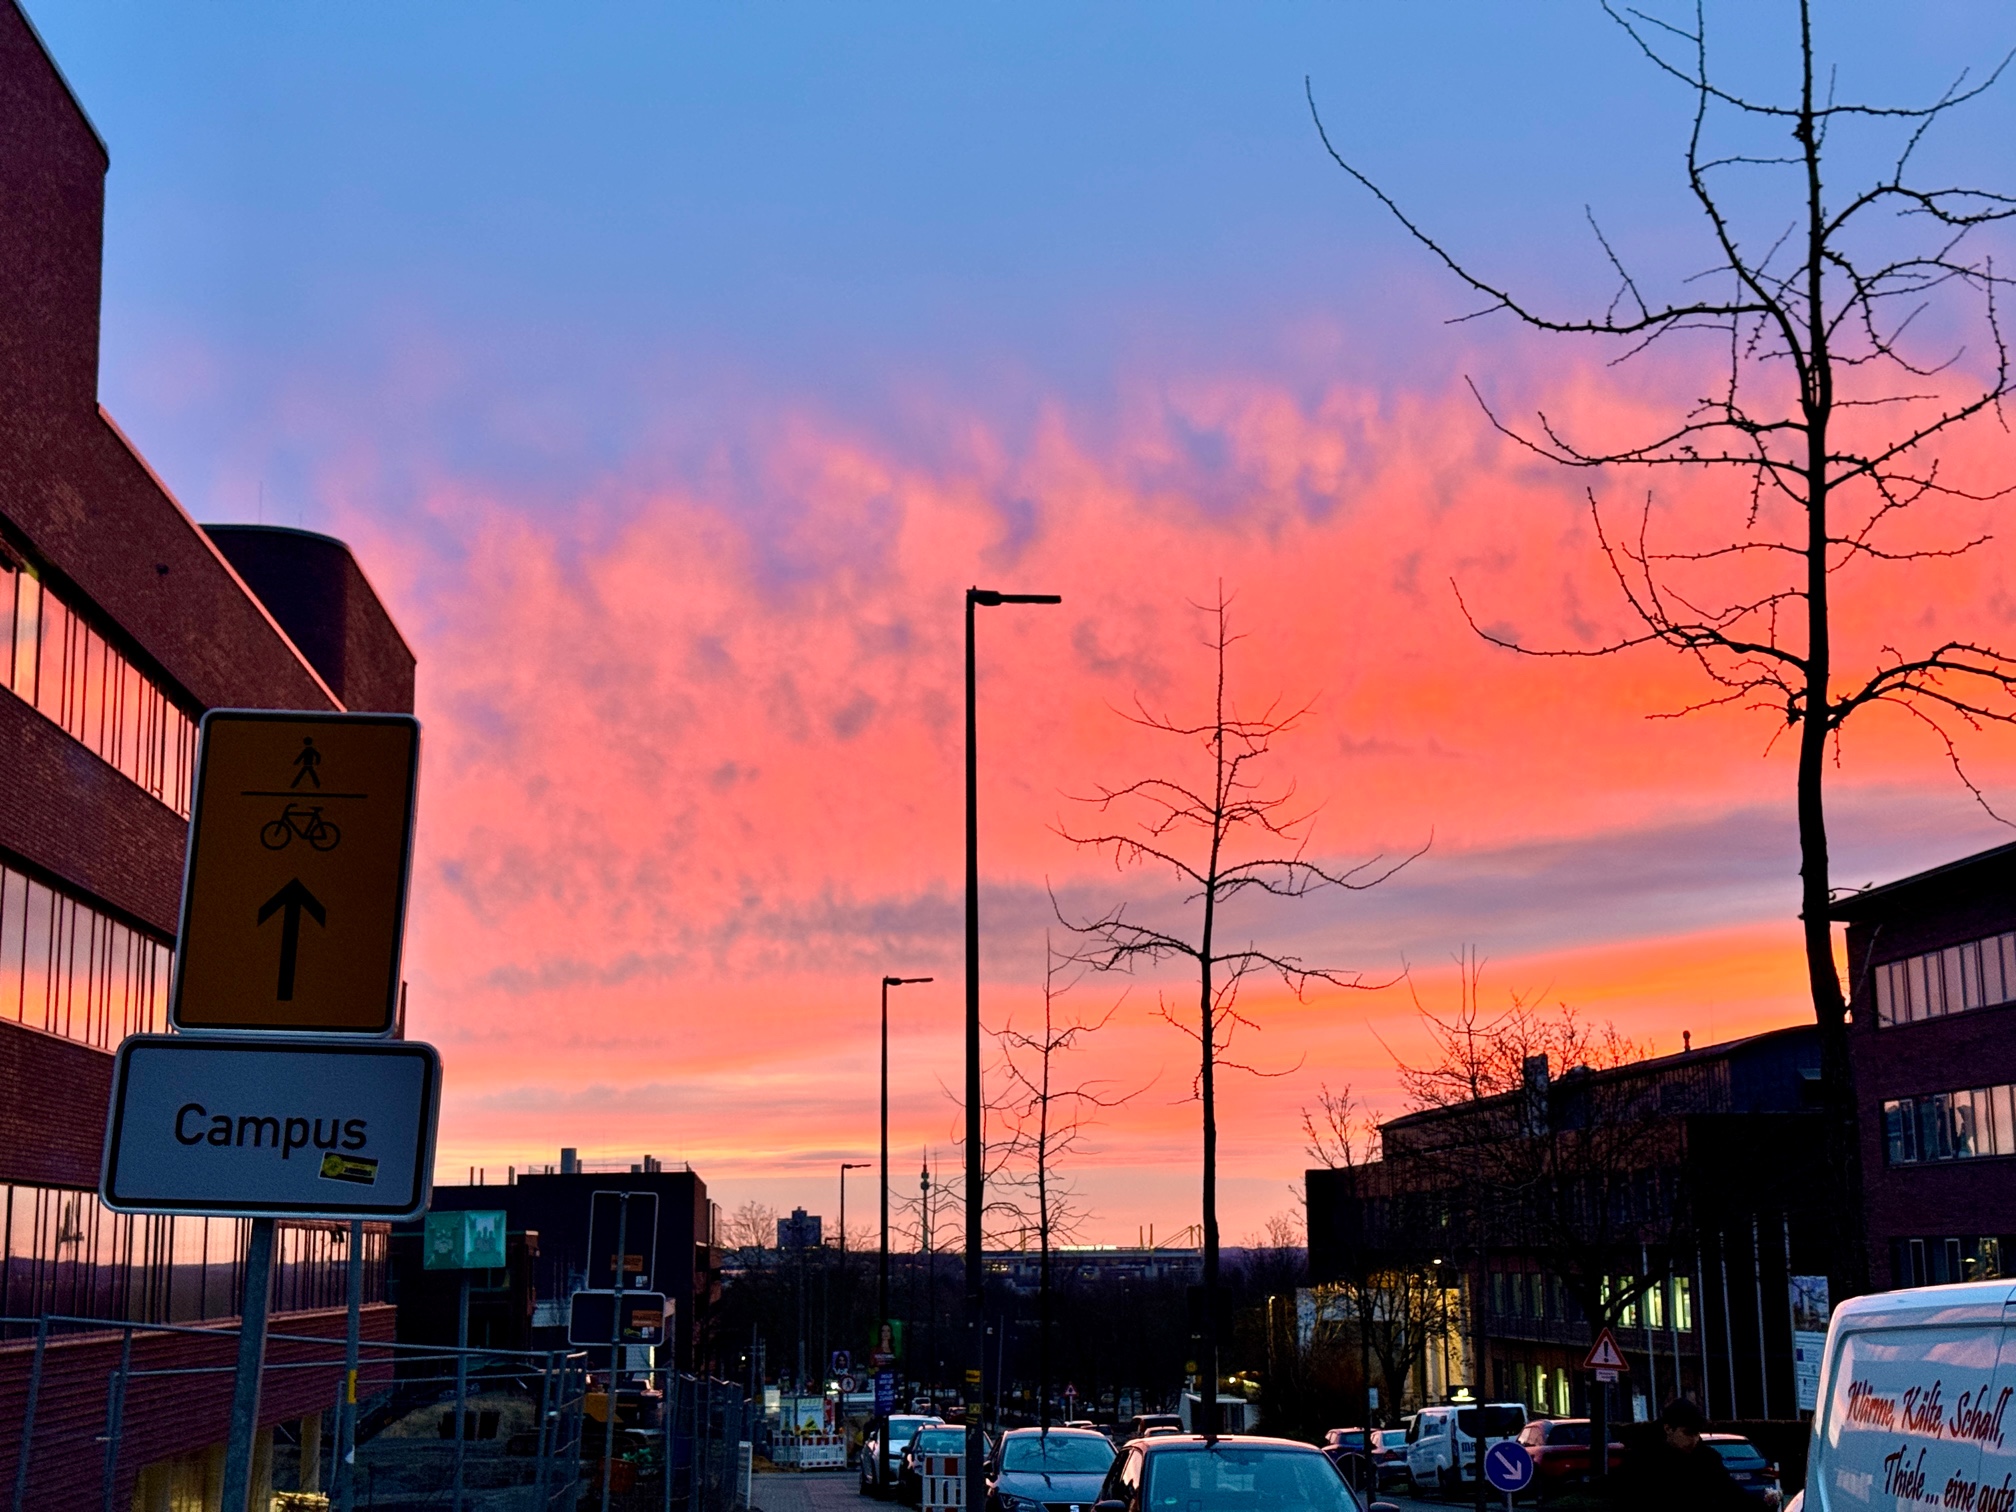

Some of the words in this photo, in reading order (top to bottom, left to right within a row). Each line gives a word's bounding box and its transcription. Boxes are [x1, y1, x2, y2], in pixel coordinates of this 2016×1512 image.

[175, 1103, 367, 1159] Campus
[1846, 1379, 1895, 1432] Wärme,
[1902, 1379, 1944, 1439] Kälte,
[1950, 1384, 2014, 1449] Schall,
[1943, 1468, 1977, 1512] eine
